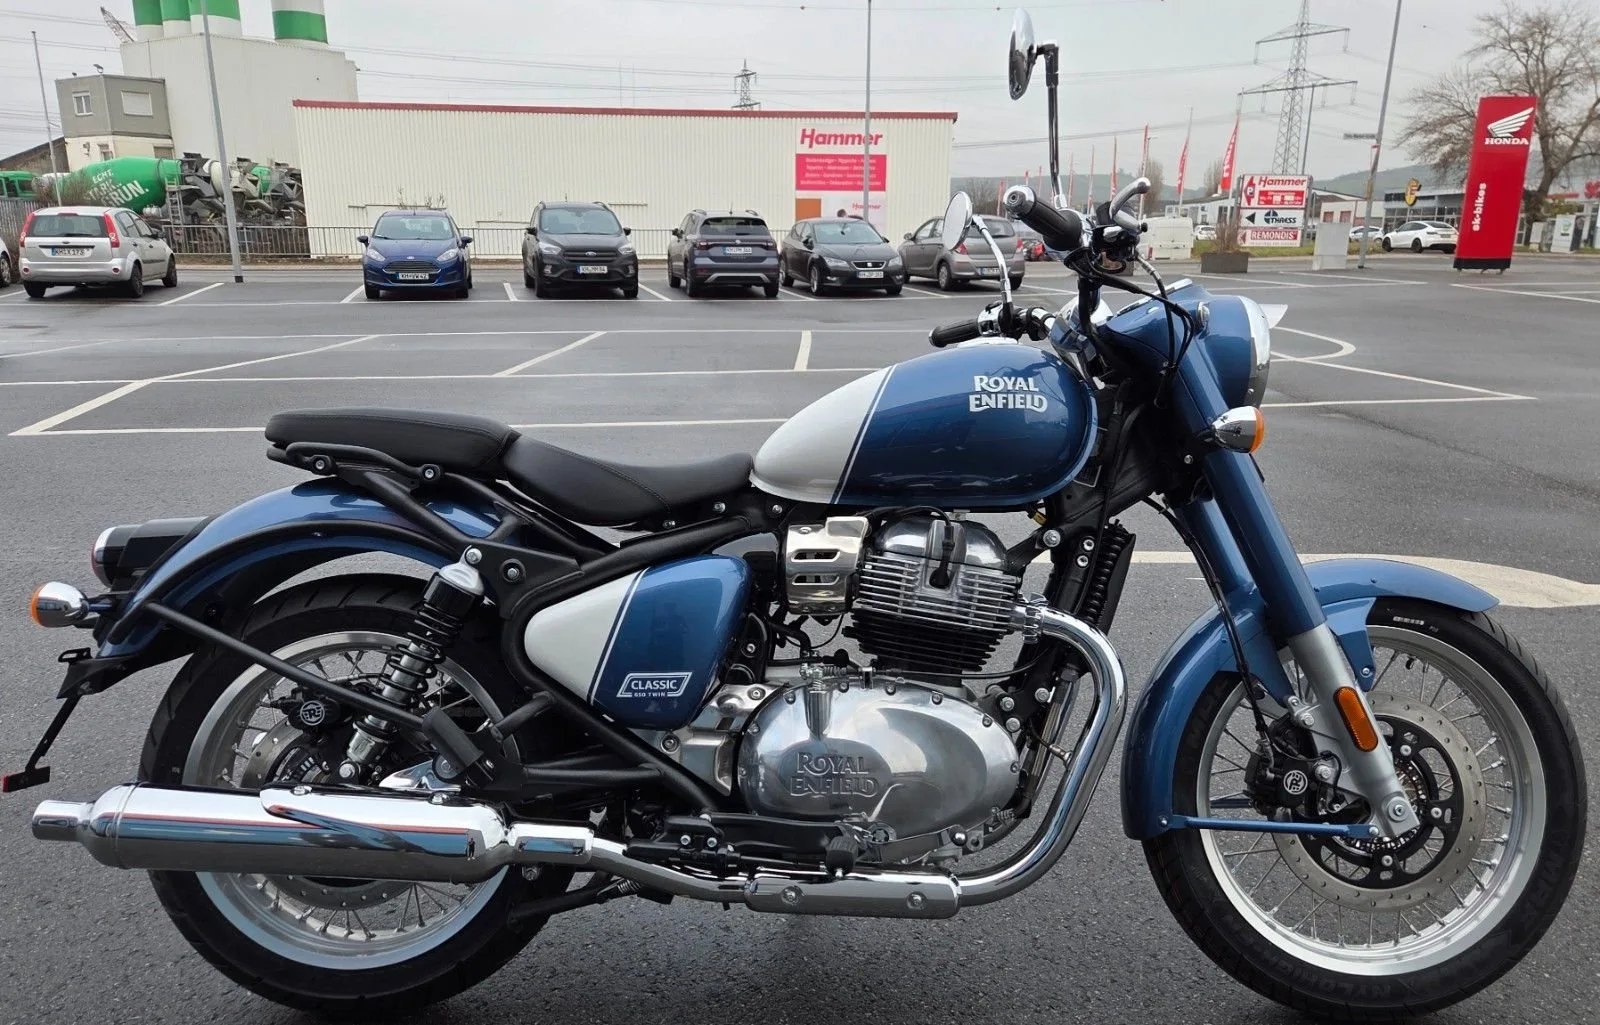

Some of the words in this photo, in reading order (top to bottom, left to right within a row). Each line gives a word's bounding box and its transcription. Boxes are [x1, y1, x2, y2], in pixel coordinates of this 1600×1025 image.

[1484, 137, 1529, 145] HONDA
[1258, 176, 1306, 187] Hammer
[1471, 182, 1487, 232] sk-bikes
[1251, 231, 1295, 240] REMONDIS
[974, 375, 1039, 393] ROYAL
[968, 393, 1048, 413] ENFIELD
[631, 680, 678, 690] CLASSIC
[797, 752, 869, 776] ROYAL
[788, 776, 879, 797] ENFIELD
